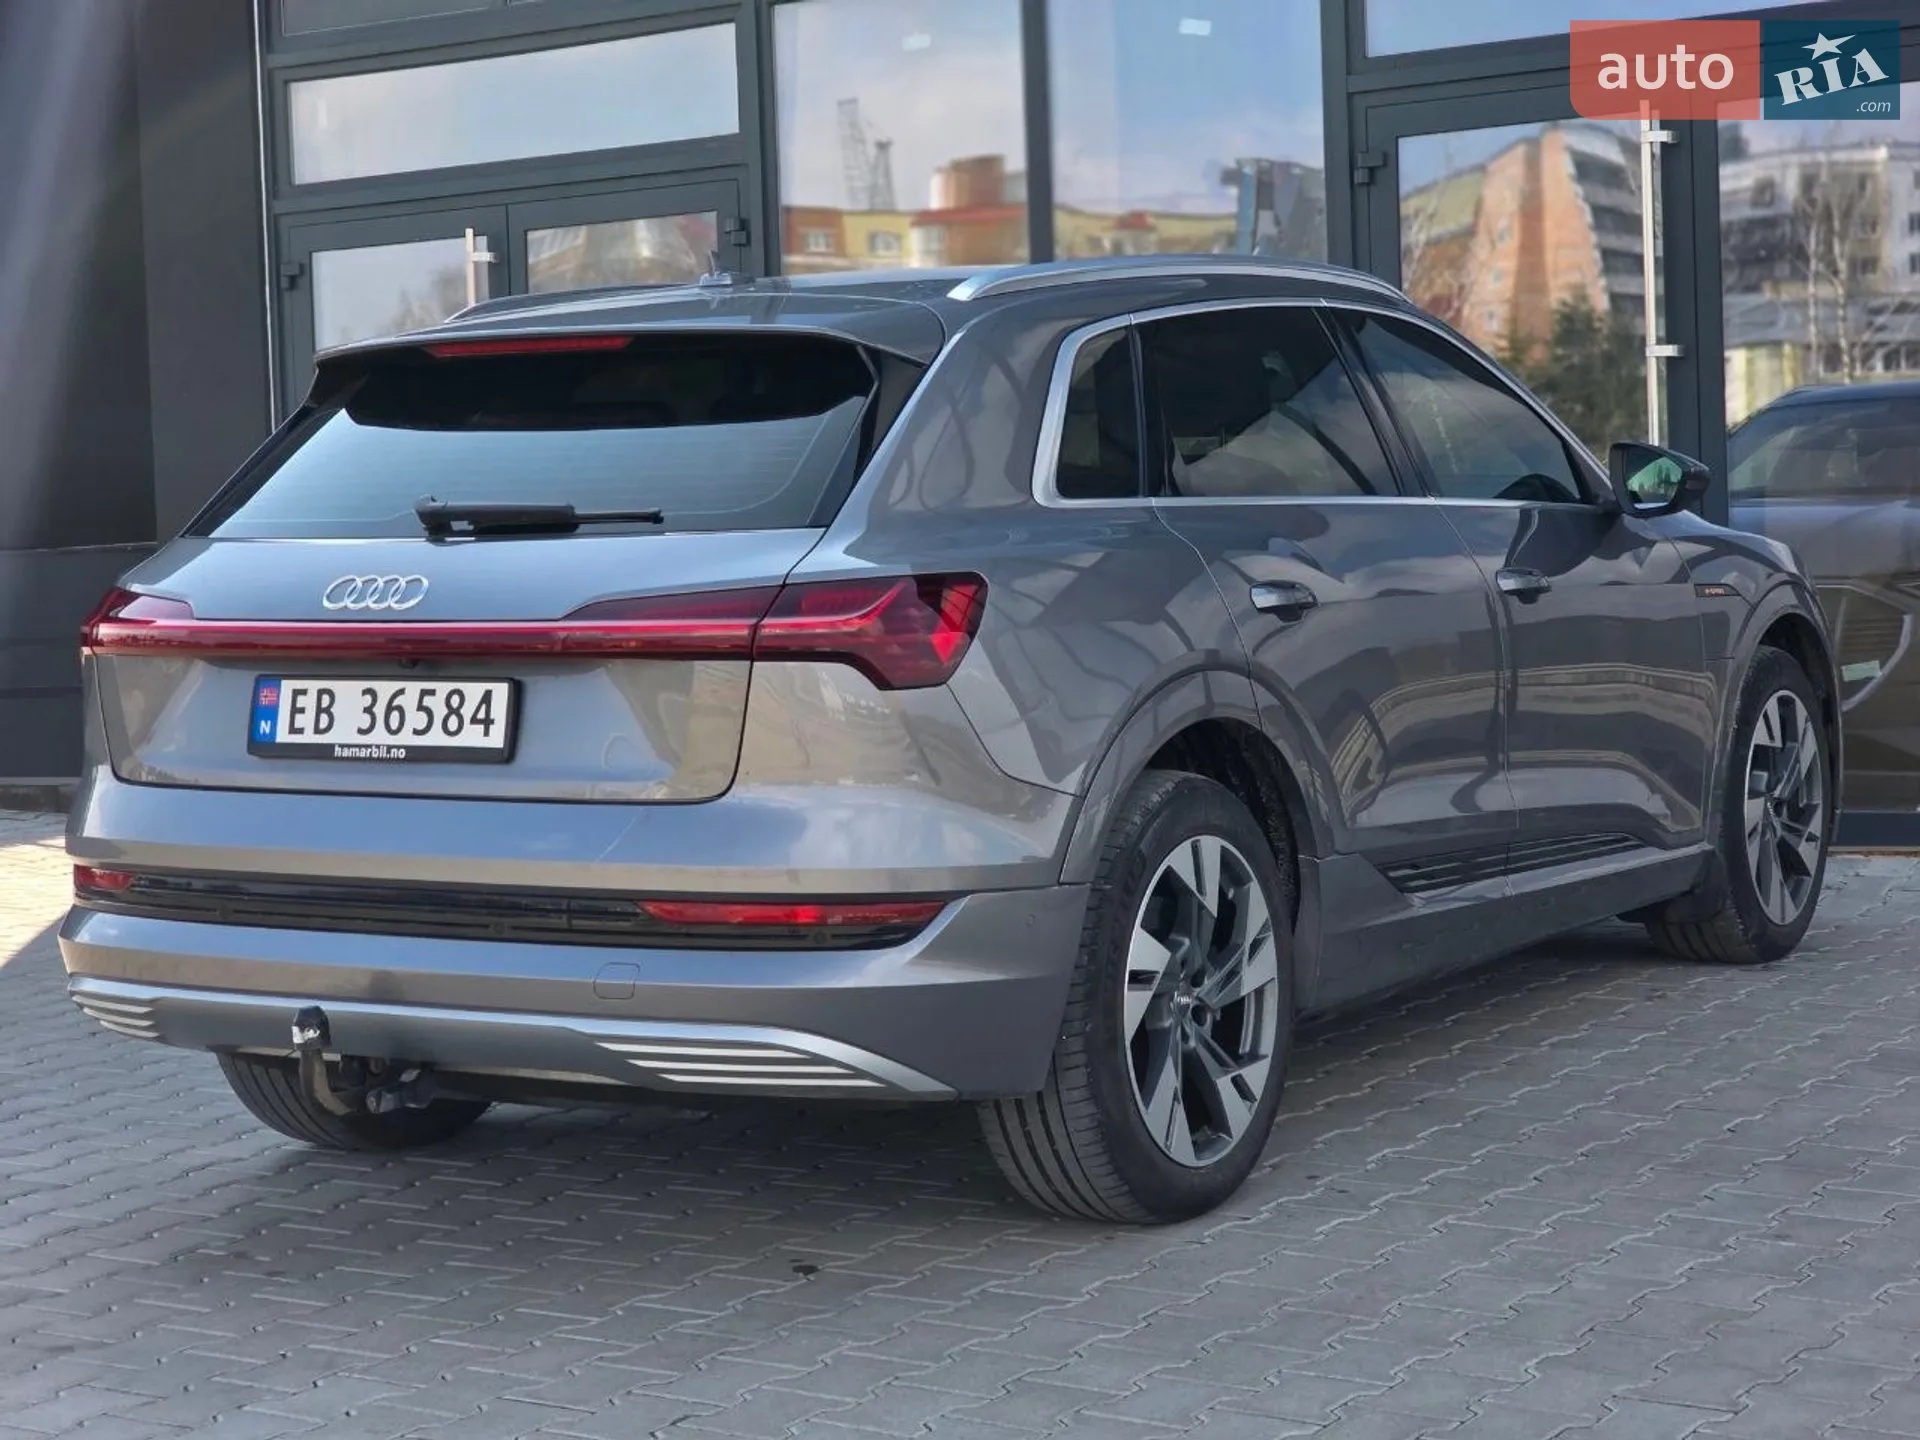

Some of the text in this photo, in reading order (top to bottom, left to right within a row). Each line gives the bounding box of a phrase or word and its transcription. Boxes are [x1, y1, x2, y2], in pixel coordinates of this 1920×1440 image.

[287, 687, 496, 738] EB 36584
[259, 719, 271, 735] N
[333, 745, 407, 760] hamarbil.no
